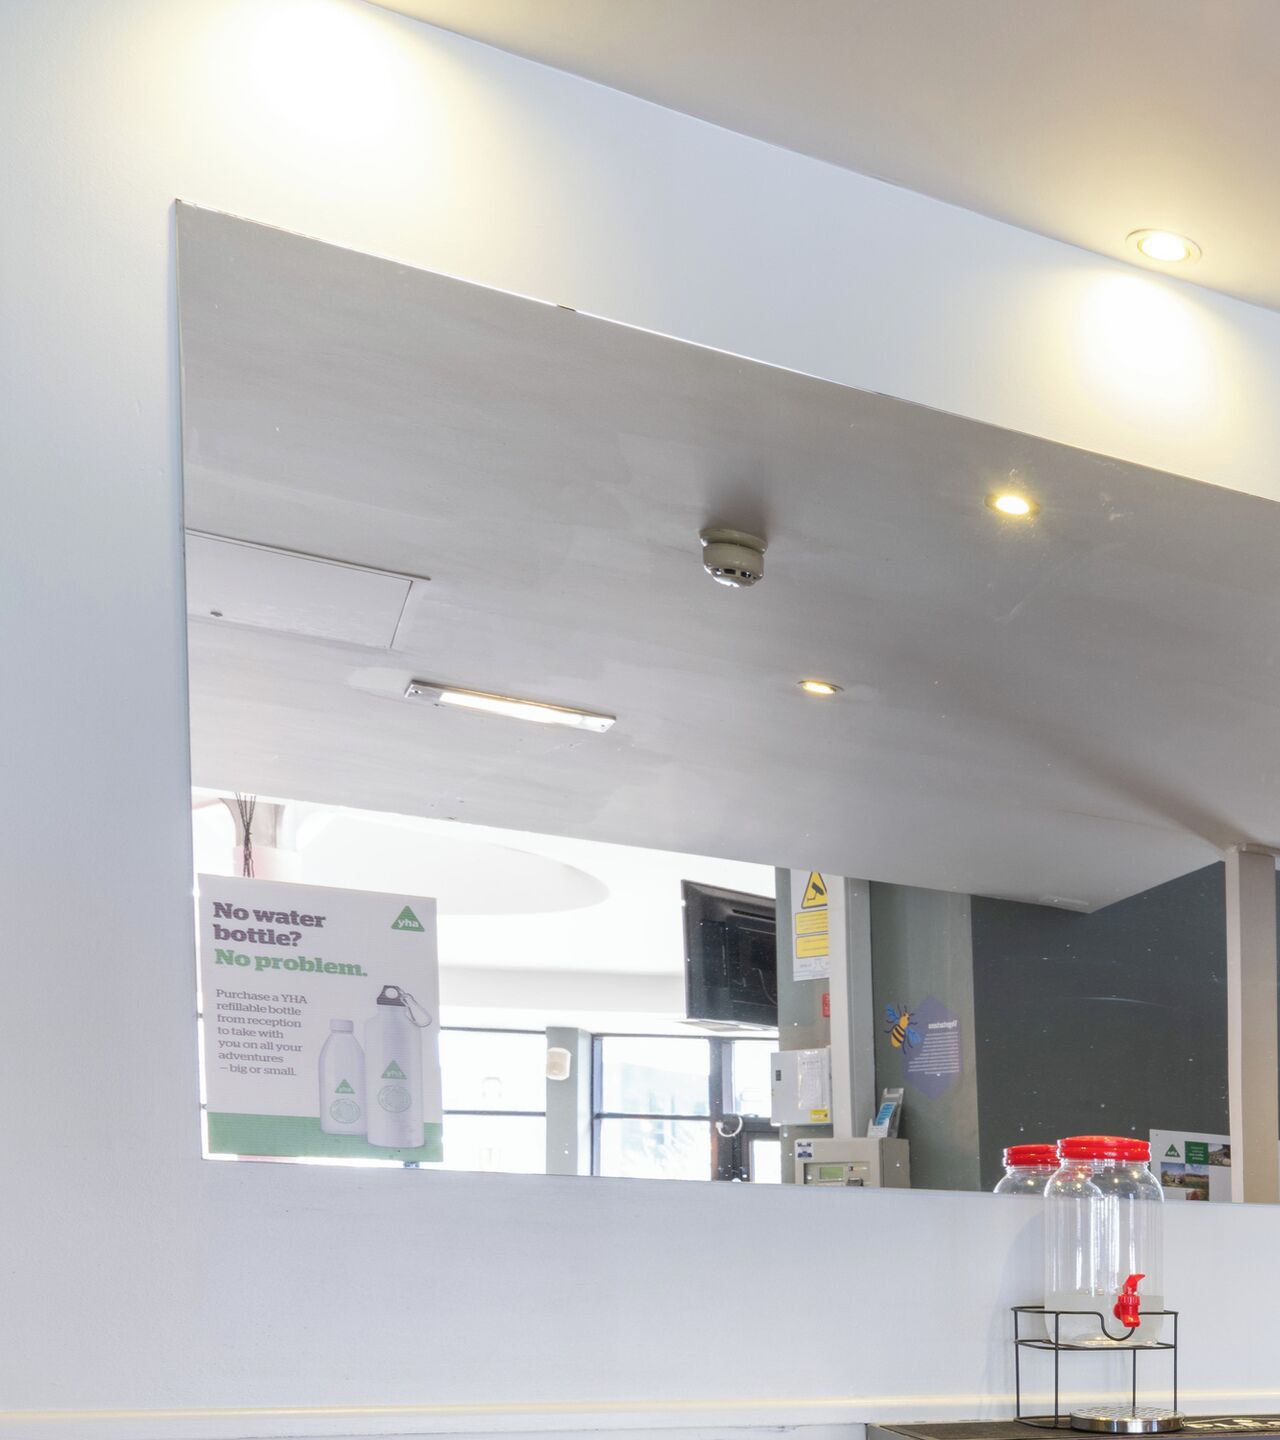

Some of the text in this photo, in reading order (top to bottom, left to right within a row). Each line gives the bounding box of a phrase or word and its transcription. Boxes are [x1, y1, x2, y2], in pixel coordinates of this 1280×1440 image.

[213, 902, 326, 928] No water
[397, 918, 420, 929] yha
[213, 923, 302, 946] bottle?
[215, 949, 369, 977] No problem.
[216, 989, 271, 1001] Purchase
[281, 994, 308, 1004] YHA
[216, 1002, 302, 1015] refillable bottle
[217, 1014, 302, 1028] from reception
[218, 1026, 284, 1039] to take with
[218, 1040, 304, 1052] you on all your
[218, 1051, 285, 1063] adventures
[229, 1064, 248, 1075] big
[249, 1066, 261, 1074] or
